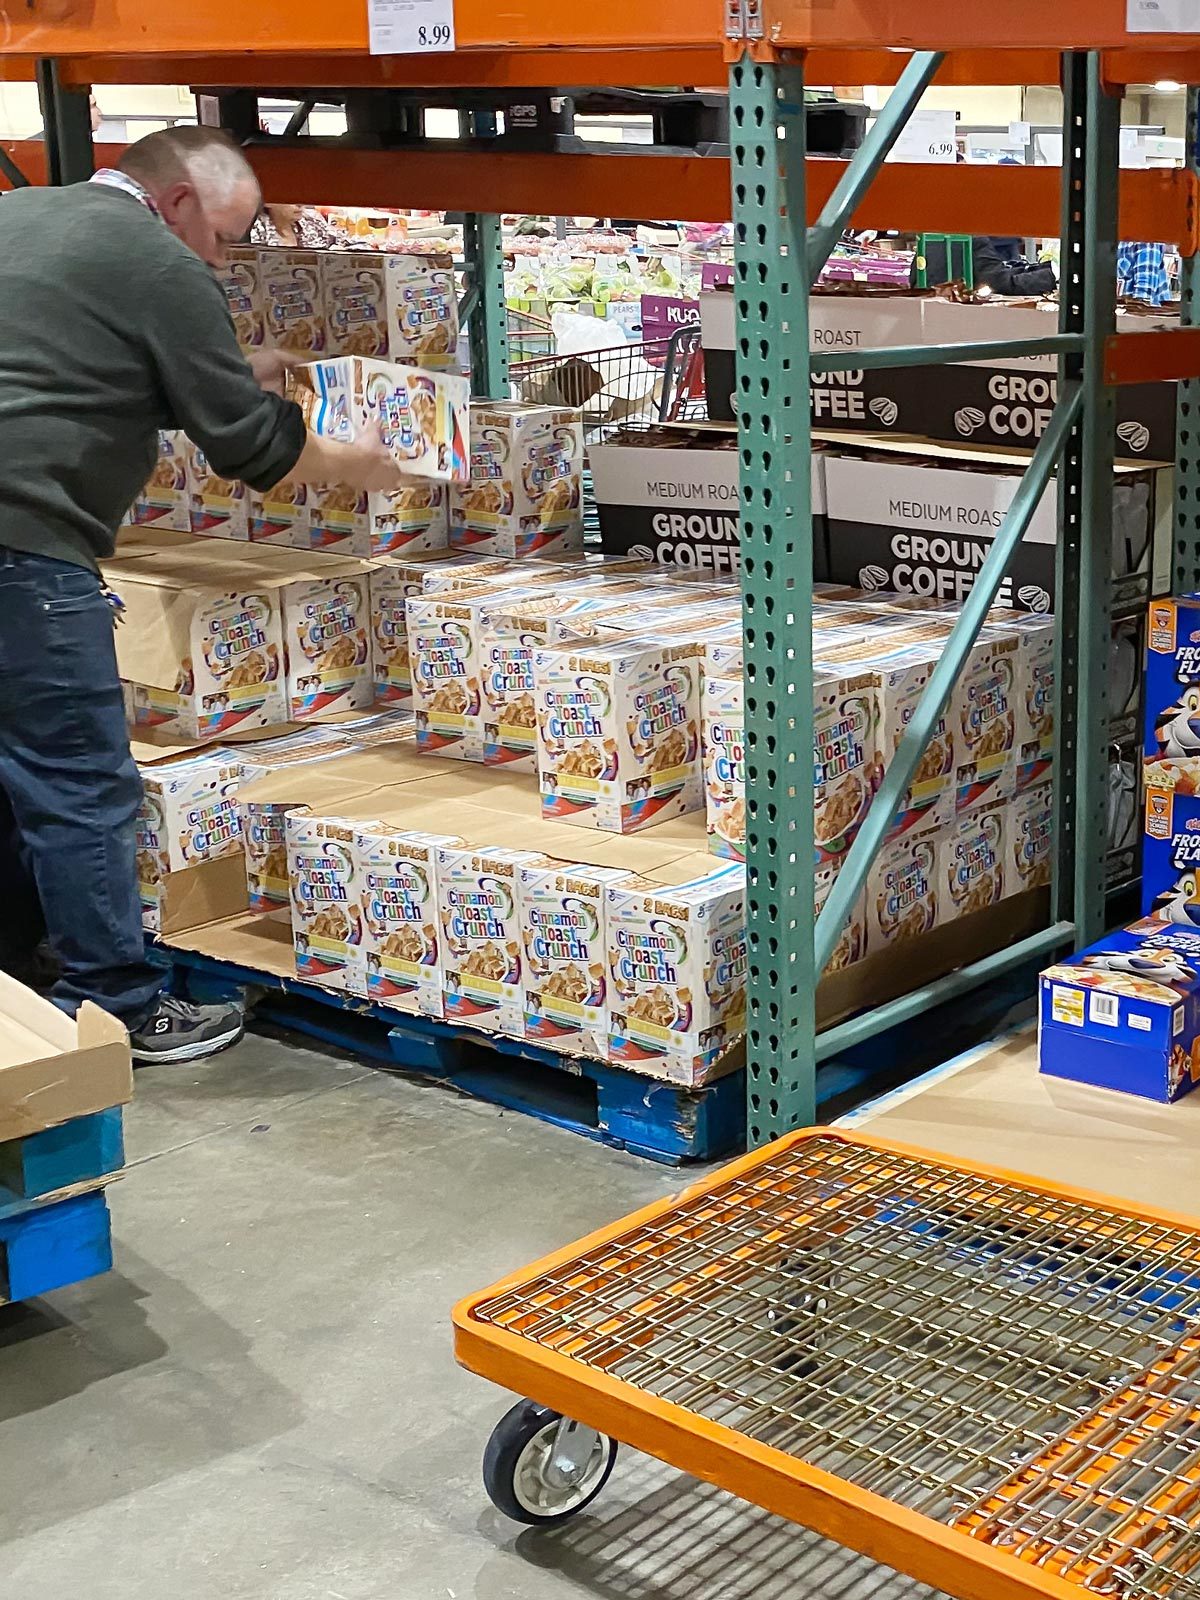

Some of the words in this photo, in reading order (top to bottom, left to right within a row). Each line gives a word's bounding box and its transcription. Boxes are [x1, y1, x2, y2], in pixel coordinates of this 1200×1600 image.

[418, 25, 450, 46] 8.99
[928, 142, 953, 156] 6.99
[814, 329, 861, 346] ROAST
[988, 375, 1058, 404] GRO
[988, 405, 1051, 438] COF
[647, 482, 703, 499] MEDIUM
[708, 484, 739, 500] ROA
[889, 500, 951, 522] MEDIUM
[652, 513, 740, 541] GROUN
[891, 534, 992, 567] GROUN
[892, 563, 1013, 608] COFFE
[309, 615, 356, 643] Crunch
[214, 629, 266, 660] Crunch
[421, 658, 466, 679] Crunch
[492, 673, 535, 692] Crunc
[545, 690, 600, 707] Cinnamon
[643, 693, 679, 719] Toast
[554, 703, 592, 721] Toast
[970, 696, 1008, 730] Crunch
[550, 717, 603, 738] Crunch
[640, 710, 687, 740] Crunch
[818, 732, 856, 761] Toast
[200, 808, 238, 834] Toast
[388, 841, 397, 854] 2
[472, 857, 481, 872] 2
[957, 849, 996, 886] Crunch
[303, 868, 337, 885] Toast
[367, 874, 418, 891] Cinnamon
[555, 877, 564, 891] 2
[891, 869, 922, 895] Toast
[301, 881, 347, 902] Crunch
[375, 887, 410, 906] Toast
[449, 889, 503, 907] Cinnamon
[886, 877, 929, 916] Crunch
[371, 901, 423, 922] Crunch
[458, 905, 494, 922] Toast
[643, 898, 653, 912] 2
[453, 917, 505, 939] Crunch
[530, 908, 586, 929] Cinnamon
[540, 925, 577, 944] Toast
[617, 928, 676, 950] Cinnamon
[535, 938, 589, 961] Crunch
[627, 946, 665, 966] Toast
[620, 958, 677, 984] Crunch
